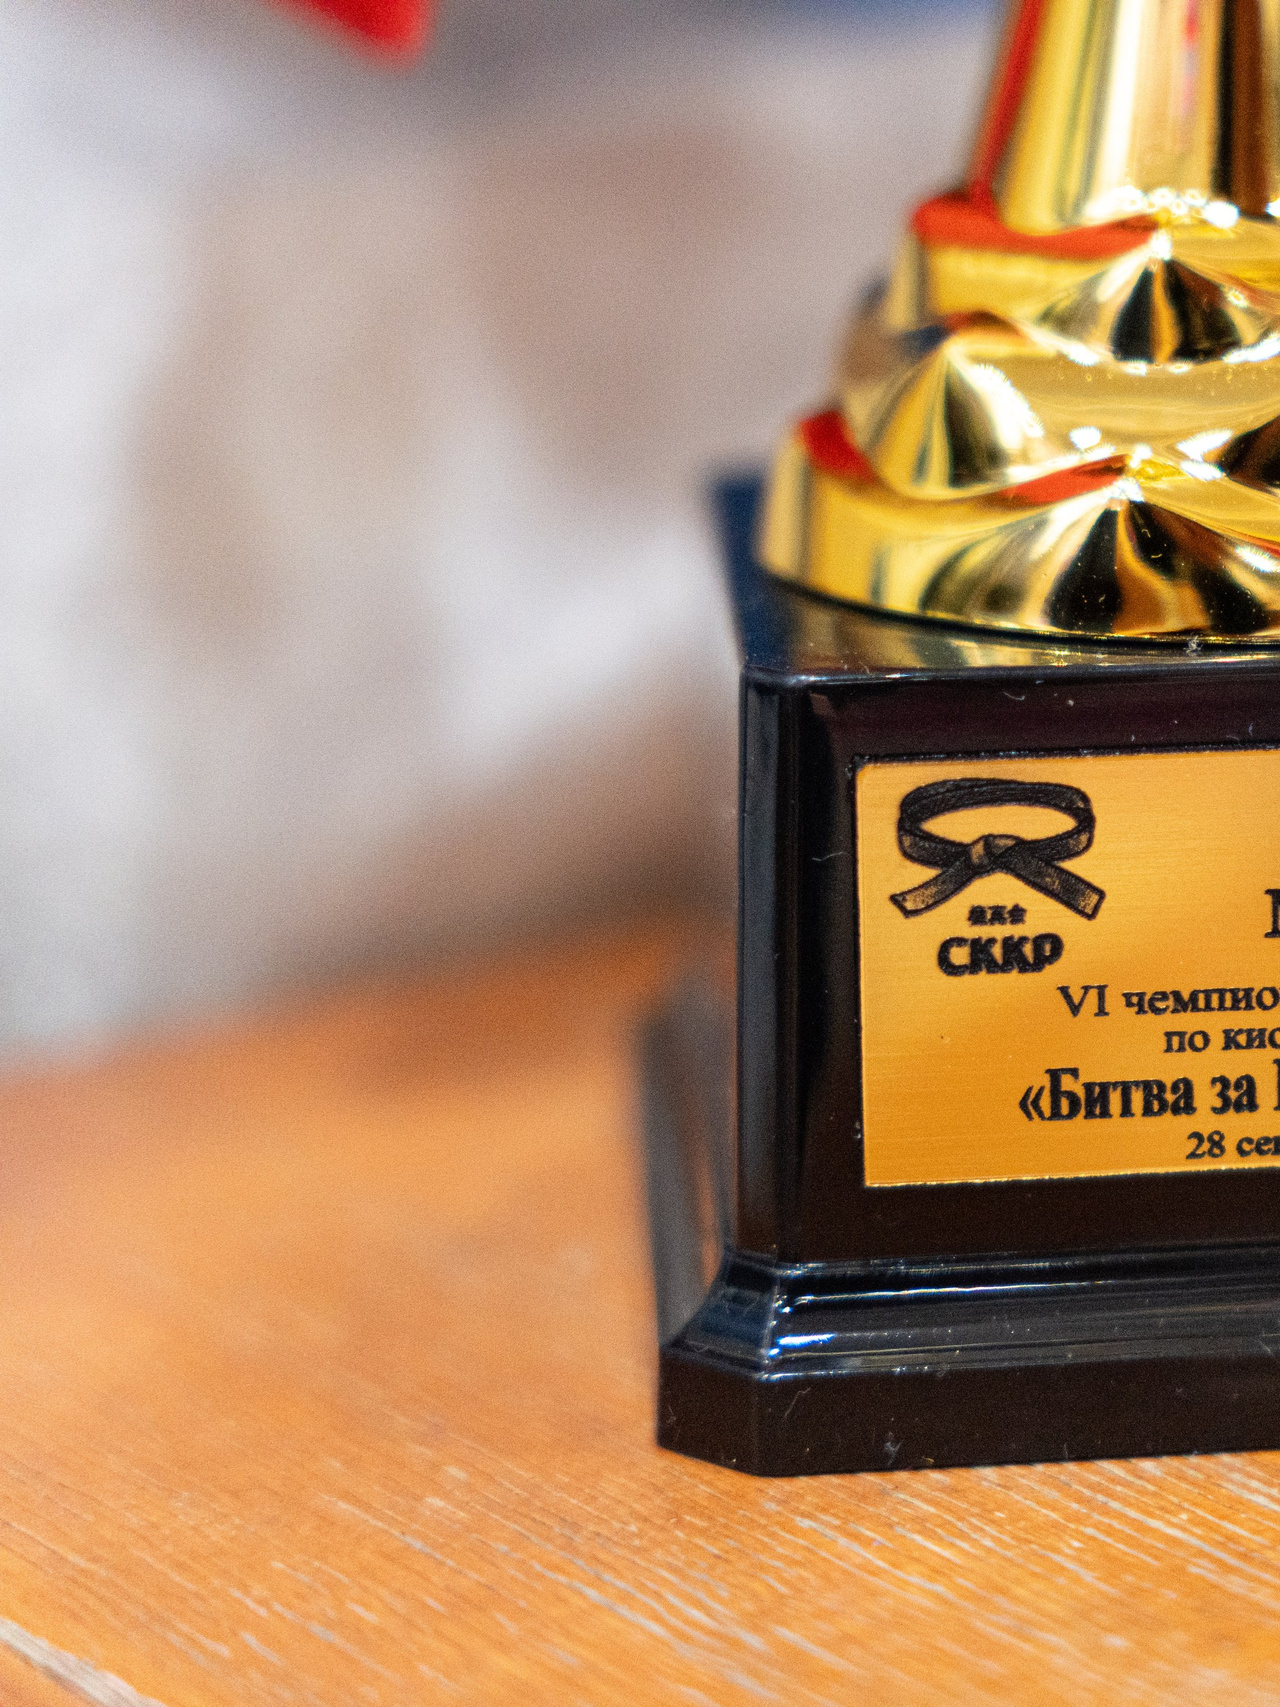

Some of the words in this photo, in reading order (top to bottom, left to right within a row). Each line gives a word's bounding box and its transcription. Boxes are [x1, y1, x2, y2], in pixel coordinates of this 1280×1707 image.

[936, 931, 1065, 977] СККР
[1057, 984, 1110, 1018] VI
[1163, 1030, 1211, 1054] по
[1018, 1067, 1197, 1122] «Битва
[1210, 1073, 1260, 1115] за
[1185, 1130, 1227, 1160] 28
